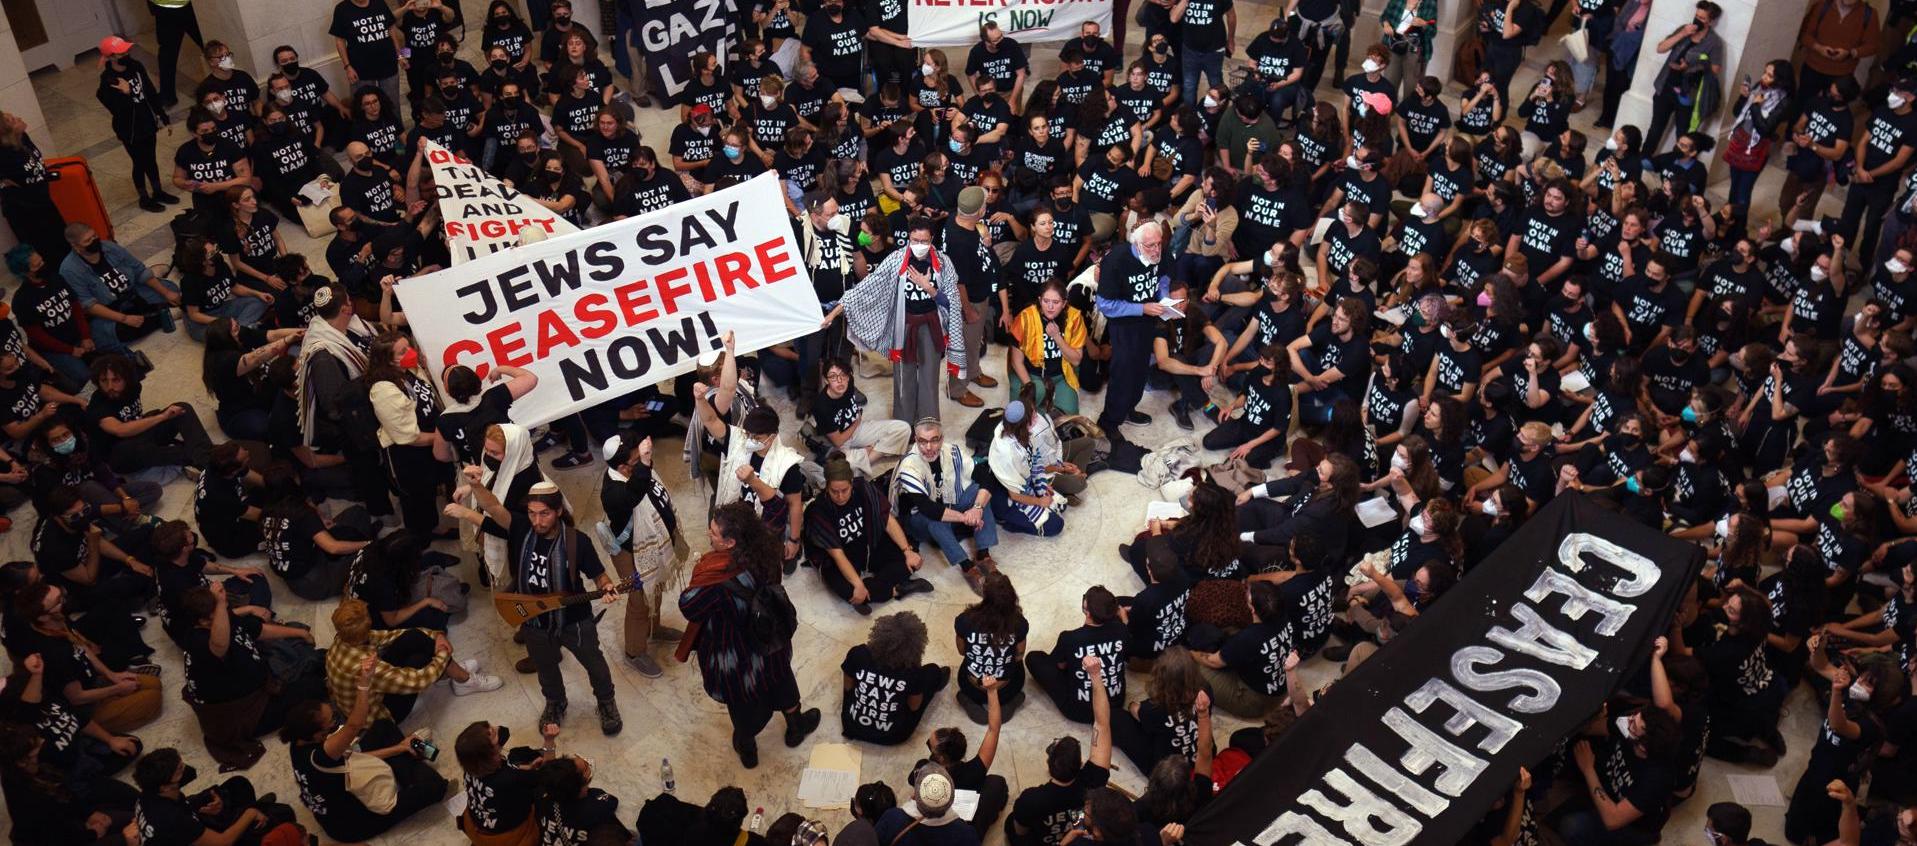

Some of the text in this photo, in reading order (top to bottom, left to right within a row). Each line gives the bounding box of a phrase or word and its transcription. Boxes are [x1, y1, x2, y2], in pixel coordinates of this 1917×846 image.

[352, 18, 372, 28] NOT
[428, 23, 436, 31] IN
[642, 0, 738, 52] GAZ
[979, 9, 1055, 31] IS NOW
[360, 22, 384, 33] OUR
[358, 30, 389, 43] NAME
[414, 31, 434, 41] OUR
[831, 32, 849, 40] NOT
[838, 37, 858, 47] OUR
[659, 23, 738, 96] LVE
[1260, 56, 1289, 66] JEWS
[744, 78, 761, 86] NOT
[1147, 77, 1168, 86] OUR
[696, 94, 713, 103] NOT
[569, 108, 587, 118] NOT
[574, 114, 595, 123] OUR
[1407, 111, 1439, 124] NOT IN
[1115, 118, 1124, 126] IN
[1411, 119, 1434, 130] OUR
[1810, 121, 1828, 137] OUR
[1812, 112, 1837, 133] NOT IN
[1874, 118, 1902, 137] NOT IN
[367, 125, 396, 141] NOT IN
[758, 126, 782, 135] OUR
[1102, 126, 1124, 138] OUR
[1873, 128, 1893, 143] OUR
[374, 134, 396, 146] OUR
[1098, 132, 1129, 145] NAME
[1298, 134, 1325, 152] NOT IN
[273, 147, 294, 159] NOT
[688, 147, 710, 156] OUR
[1161, 142, 1174, 155] NOT
[282, 150, 302, 164] OUR
[607, 154, 626, 163] OUR
[191, 159, 226, 170] NOT IN
[805, 164, 814, 172] IN
[911, 162, 921, 170] IN
[1494, 162, 1504, 172] IN
[193, 170, 223, 178] OUR
[894, 171, 918, 181] OUR
[1092, 172, 1119, 189] NOT IN
[365, 185, 382, 197] NOT
[634, 185, 668, 198] NOT IN
[1090, 179, 1111, 193] OUR
[1435, 181, 1453, 193] OUR
[1450, 181, 1459, 189] IN
[1346, 182, 1371, 204] NOT IN
[643, 195, 667, 206] OUR
[839, 203, 859, 211] NOT
[1251, 195, 1285, 209] NOT IN
[463, 203, 522, 217] AND
[1253, 203, 1278, 216] OUR
[1245, 211, 1281, 227] NAME
[1592, 216, 1611, 233] OUR
[446, 217, 555, 241] FIGHT
[1067, 223, 1078, 231] IN
[1529, 219, 1558, 237] NOT IN
[1404, 227, 1427, 244] NOT IN
[1529, 227, 1551, 242] OUR
[1404, 235, 1421, 249] OUR
[1524, 235, 1551, 253] NAME
[1664, 236, 1686, 248] OUR
[456, 201, 739, 325] JEWS SAY
[1330, 248, 1347, 264] OUR
[1605, 253, 1623, 266] NOT
[1028, 268, 1054, 277] OUR
[1129, 271, 1150, 284] NOT
[1135, 277, 1158, 292] OUR
[1715, 275, 1746, 294] NOT IN
[37, 289, 69, 312] NOT IN
[1876, 283, 1904, 305] NOT IN
[47, 300, 70, 316] OUR
[443, 236, 797, 380] CEASEFIRE
[1634, 296, 1651, 309] NOT
[1489, 330, 1499, 340] IN
[1845, 338, 1858, 352] NOT
[559, 310, 724, 401] NOW!
[1439, 364, 1457, 381] OUR
[1454, 366, 1464, 377] IN
[1654, 374, 1677, 384] NOT
[1782, 382, 1792, 394] IN
[12, 395, 29, 413] NOT
[1260, 400, 1271, 411] IN
[1371, 388, 1399, 411] NOT IN
[1794, 477, 1808, 502] OUR
[1803, 468, 1817, 500] NOT IN
[1819, 523, 1842, 554] NOT IN
[1818, 535, 1832, 557] OUR
[1300, 576, 1333, 607] JEWS
[1156, 588, 1189, 619] JEWS
[1308, 590, 1332, 613] SAY
[1260, 622, 1293, 655] JEWS
[973, 645, 1010, 657] SAY
[1075, 641, 1123, 658] JEWS
[967, 652, 1012, 666] CEASE
[856, 669, 906, 691] JEWS
[859, 682, 896, 702] SAY
[850, 705, 893, 732] NOW
[855, 702, 888, 721] FIRE
